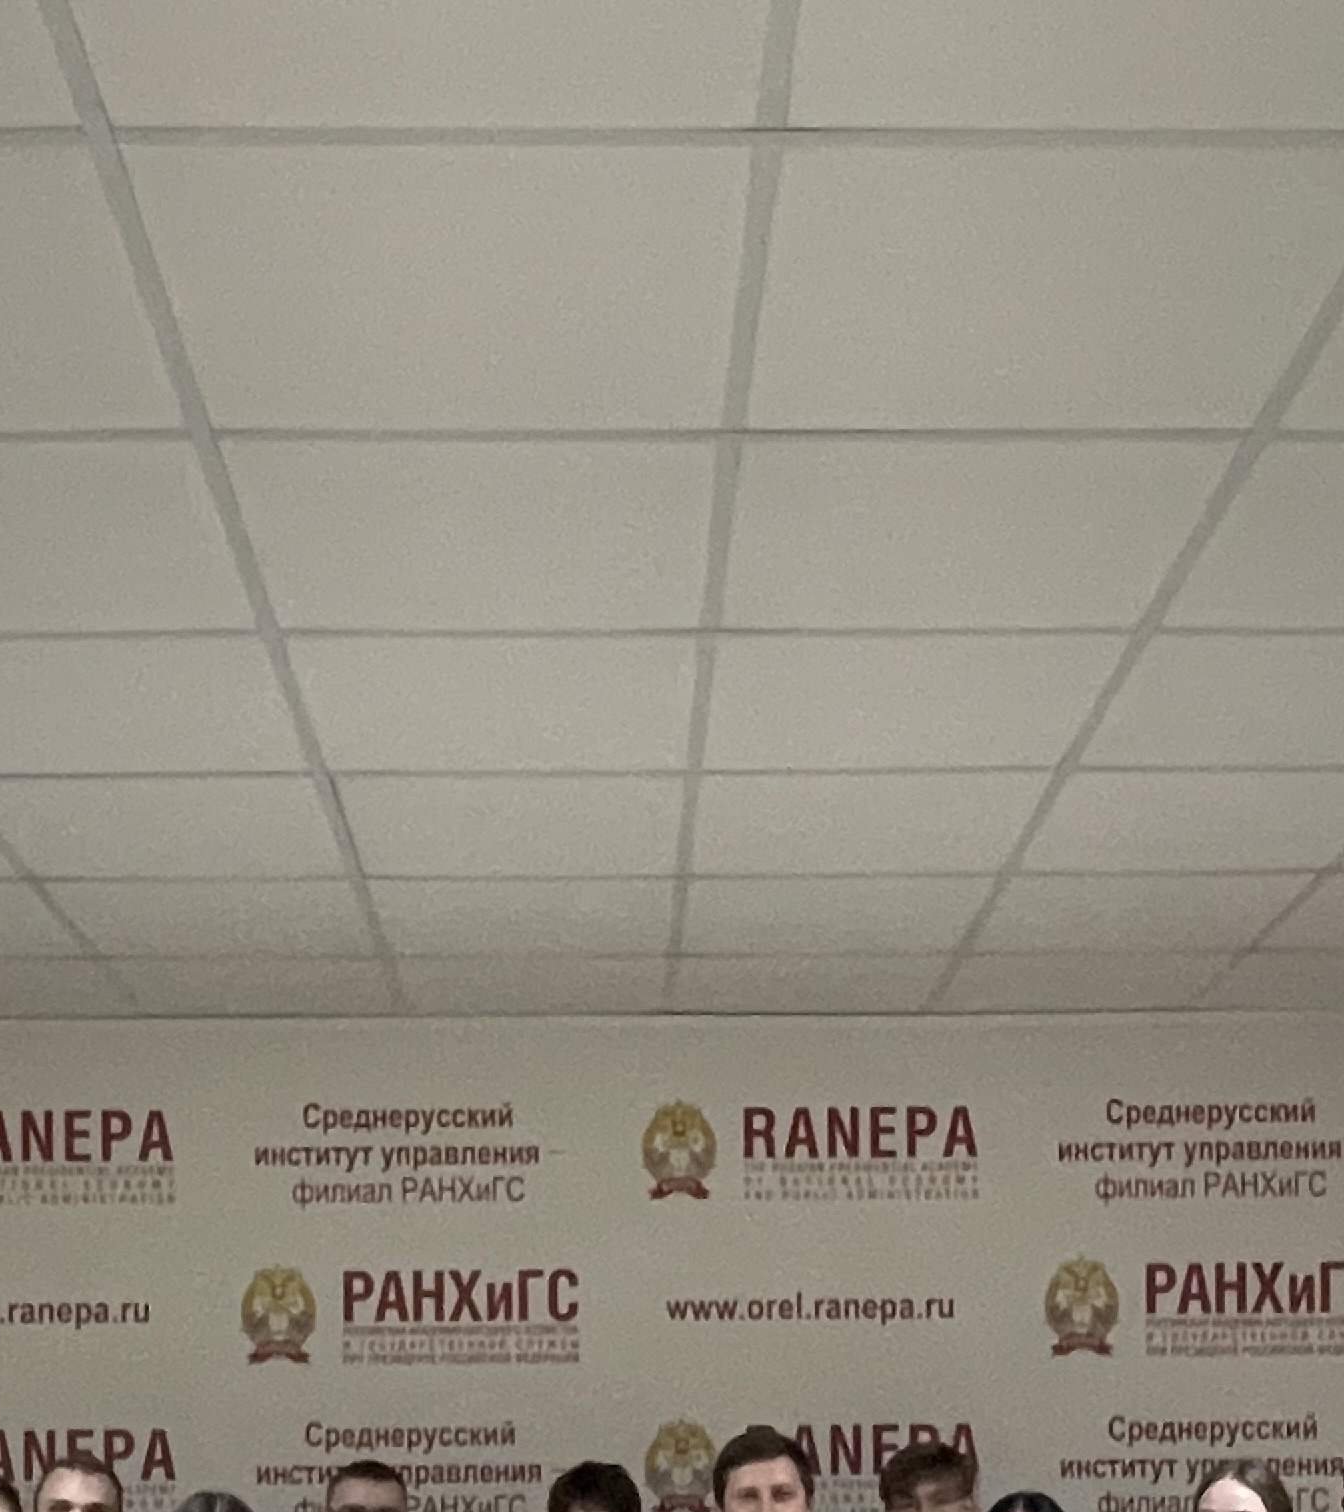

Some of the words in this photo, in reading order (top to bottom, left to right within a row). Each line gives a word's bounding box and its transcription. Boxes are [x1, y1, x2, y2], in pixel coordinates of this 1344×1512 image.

[303, 1102, 513, 1134] Среднерусский
[1106, 1097, 1316, 1129] Среднерусский
[743, 1105, 977, 1159] RANEPA
[255, 1146, 373, 1172] институт
[381, 1145, 540, 1170] управления
[1058, 1141, 1175, 1167] институт
[1184, 1139, 1342, 1165] управления
[292, 1177, 392, 1210] филиал
[401, 1176, 525, 1202] РАНХиГС
[1095, 1172, 1195, 1206] филиал
[1204, 1170, 1327, 1198] РАНХиГС
[343, 1268, 579, 1322] РАНХиГС
[666, 1291, 955, 1325] www.orel.ranepa.ru
[306, 1421, 516, 1453] Среднерусский
[1108, 1412, 1318, 1447] Среднерусский
[398, 1464, 542, 1488] правления
[1060, 1457, 1177, 1484] институт
